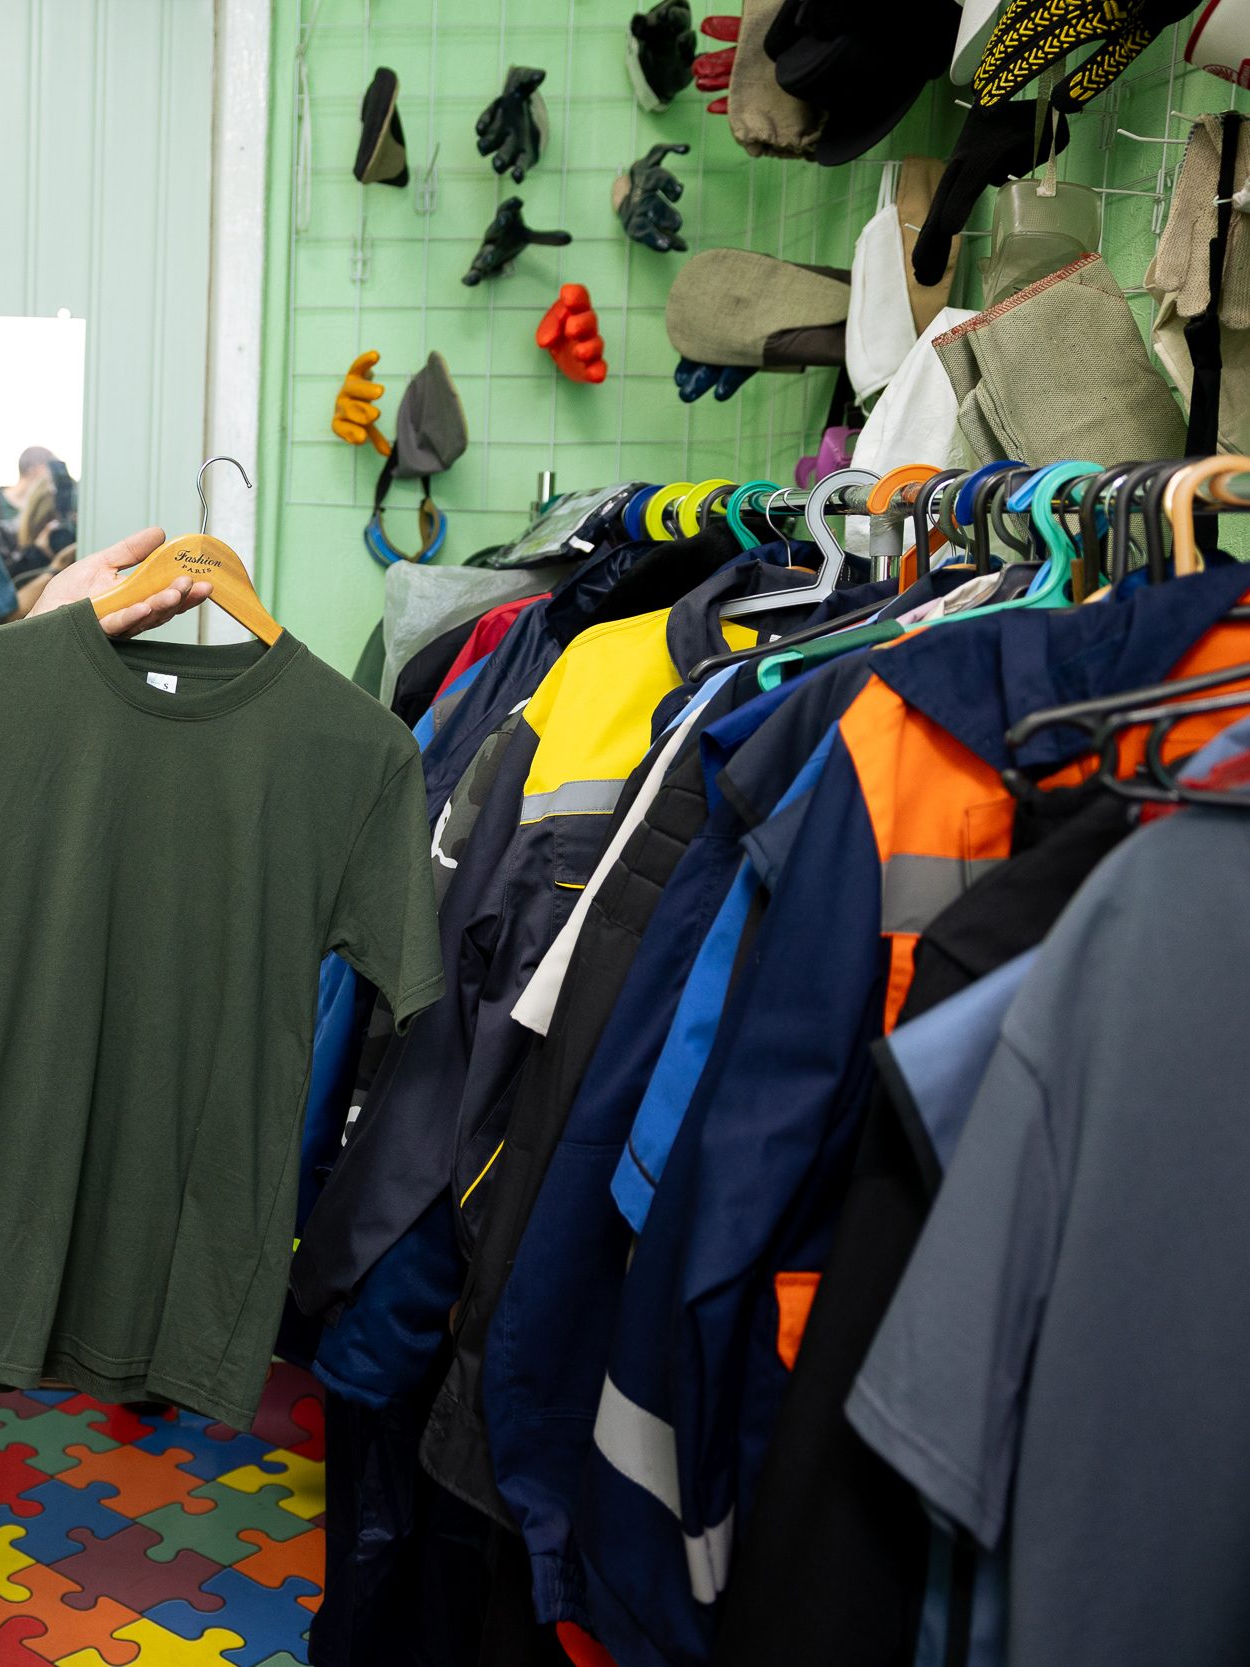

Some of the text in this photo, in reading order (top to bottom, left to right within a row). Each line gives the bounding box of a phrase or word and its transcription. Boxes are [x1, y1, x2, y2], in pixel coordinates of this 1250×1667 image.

[174, 549, 223, 568] Fashion
[181, 564, 212, 574] PARIS
[163, 682, 169, 690] S
